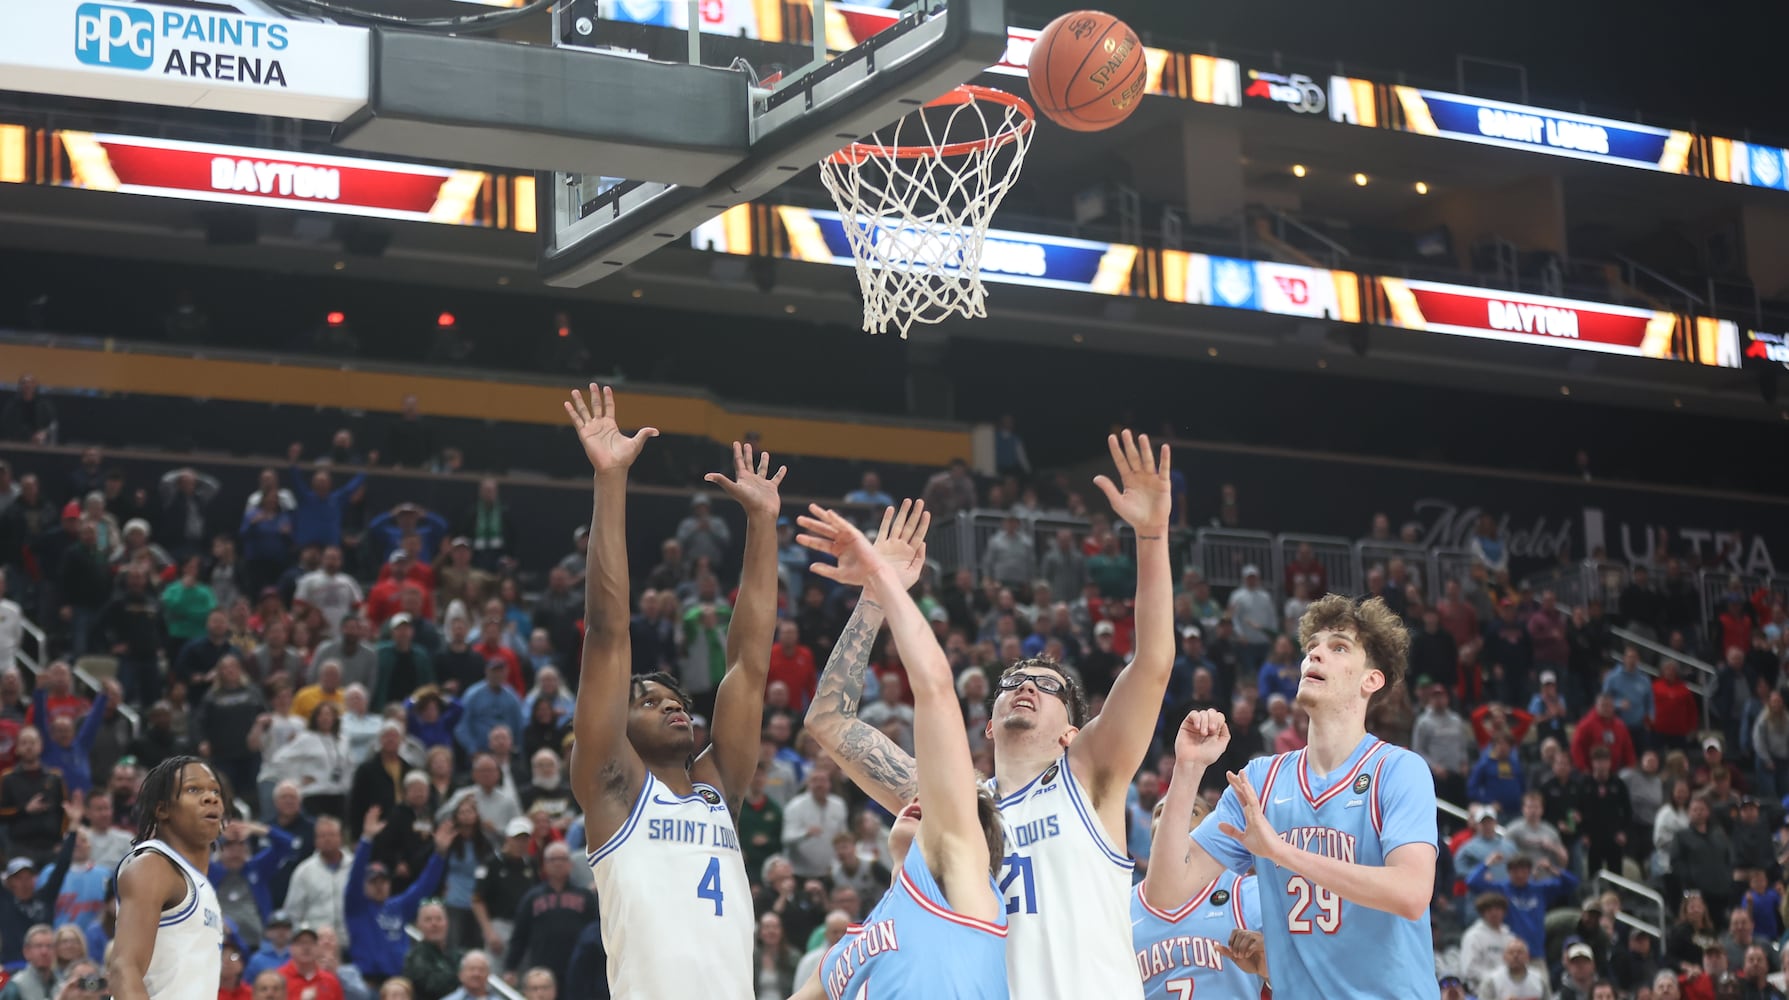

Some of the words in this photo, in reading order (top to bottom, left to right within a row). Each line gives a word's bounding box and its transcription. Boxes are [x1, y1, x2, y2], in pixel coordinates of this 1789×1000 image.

[162, 11, 289, 51] PAINTS
[163, 48, 288, 87] ARENA
[210, 156, 340, 201] DAYTON
[1487, 299, 1580, 339] DAYTON
[648, 818, 707, 846] SAINT
[697, 856, 724, 917] 4
[999, 852, 1039, 915] 21
[1287, 875, 1343, 935] 29
[1136, 935, 1224, 984] DAYTON
